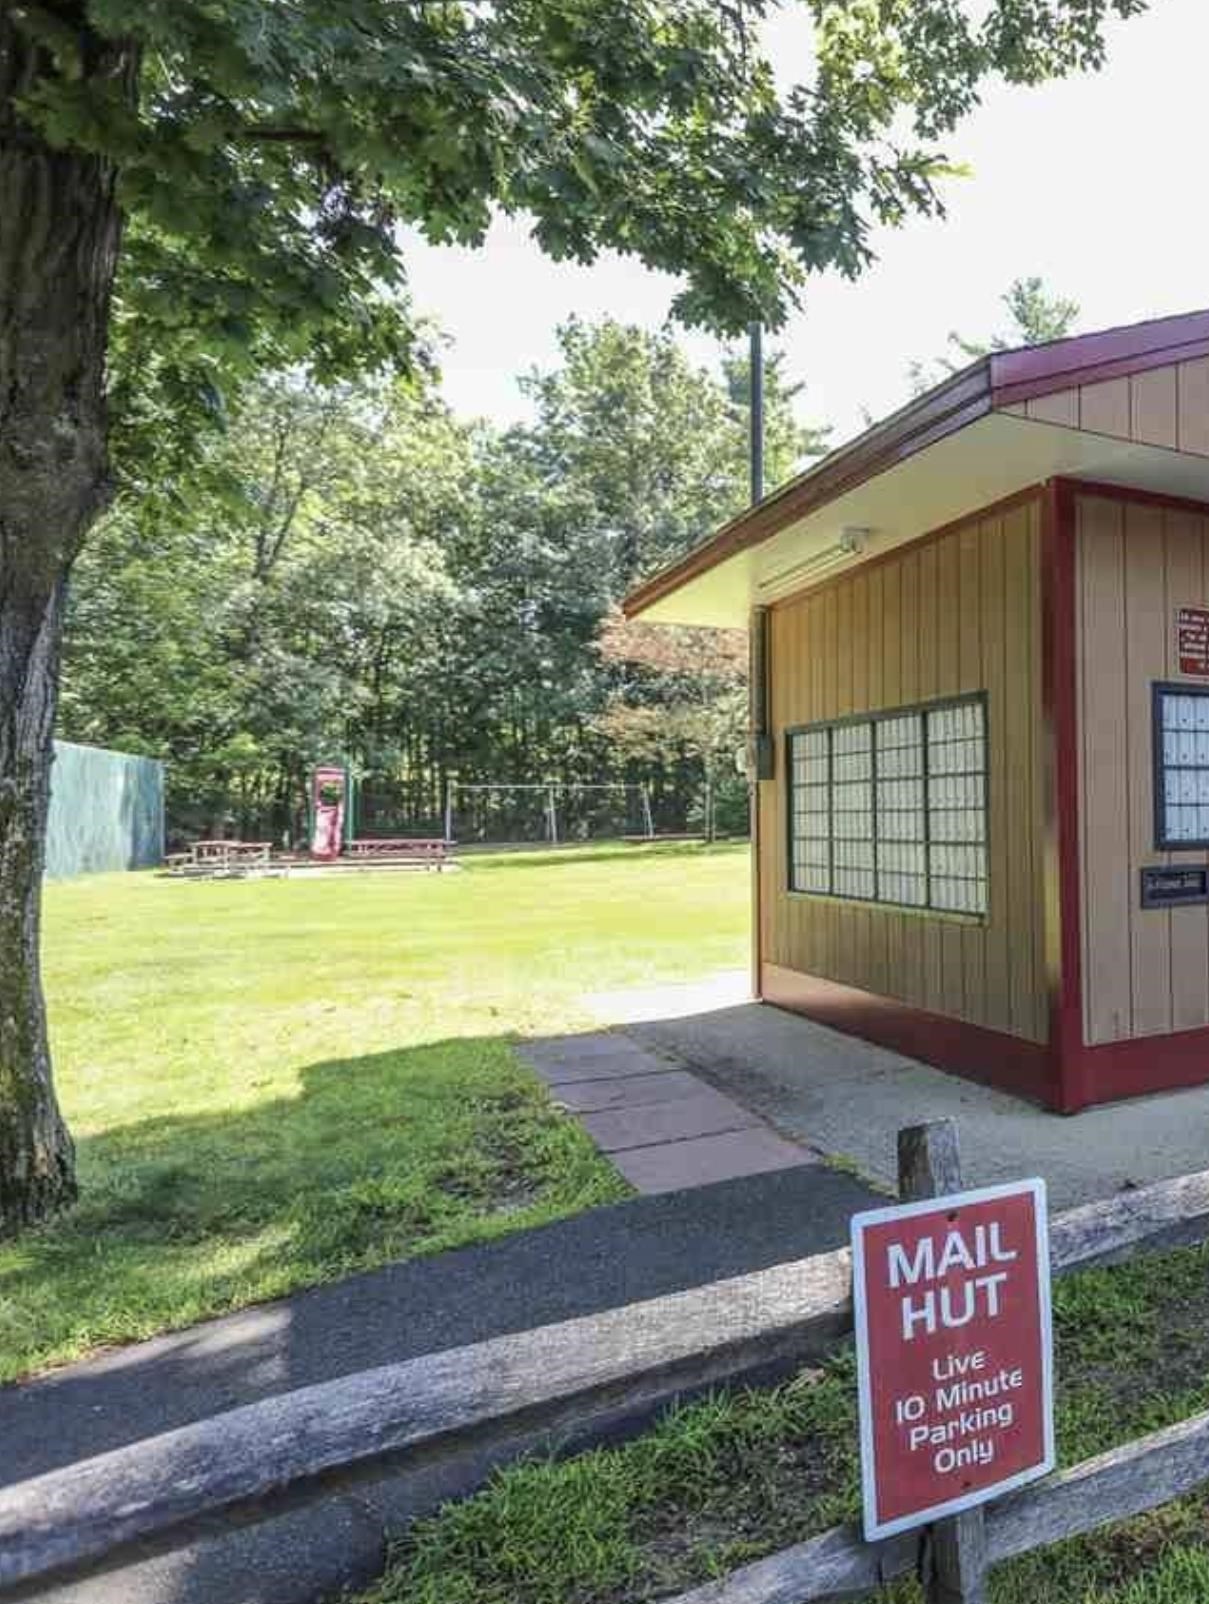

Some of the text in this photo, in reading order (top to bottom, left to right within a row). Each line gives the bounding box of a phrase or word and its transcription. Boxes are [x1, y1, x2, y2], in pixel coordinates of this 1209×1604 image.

[886, 1222, 1017, 1288] MAIL
[902, 1272, 1007, 1341] HUT
[932, 1351, 986, 1380] Live
[896, 1368, 1024, 1425] 10 Minute
[910, 1403, 1013, 1450] Parking
[934, 1438, 995, 1473] Only
